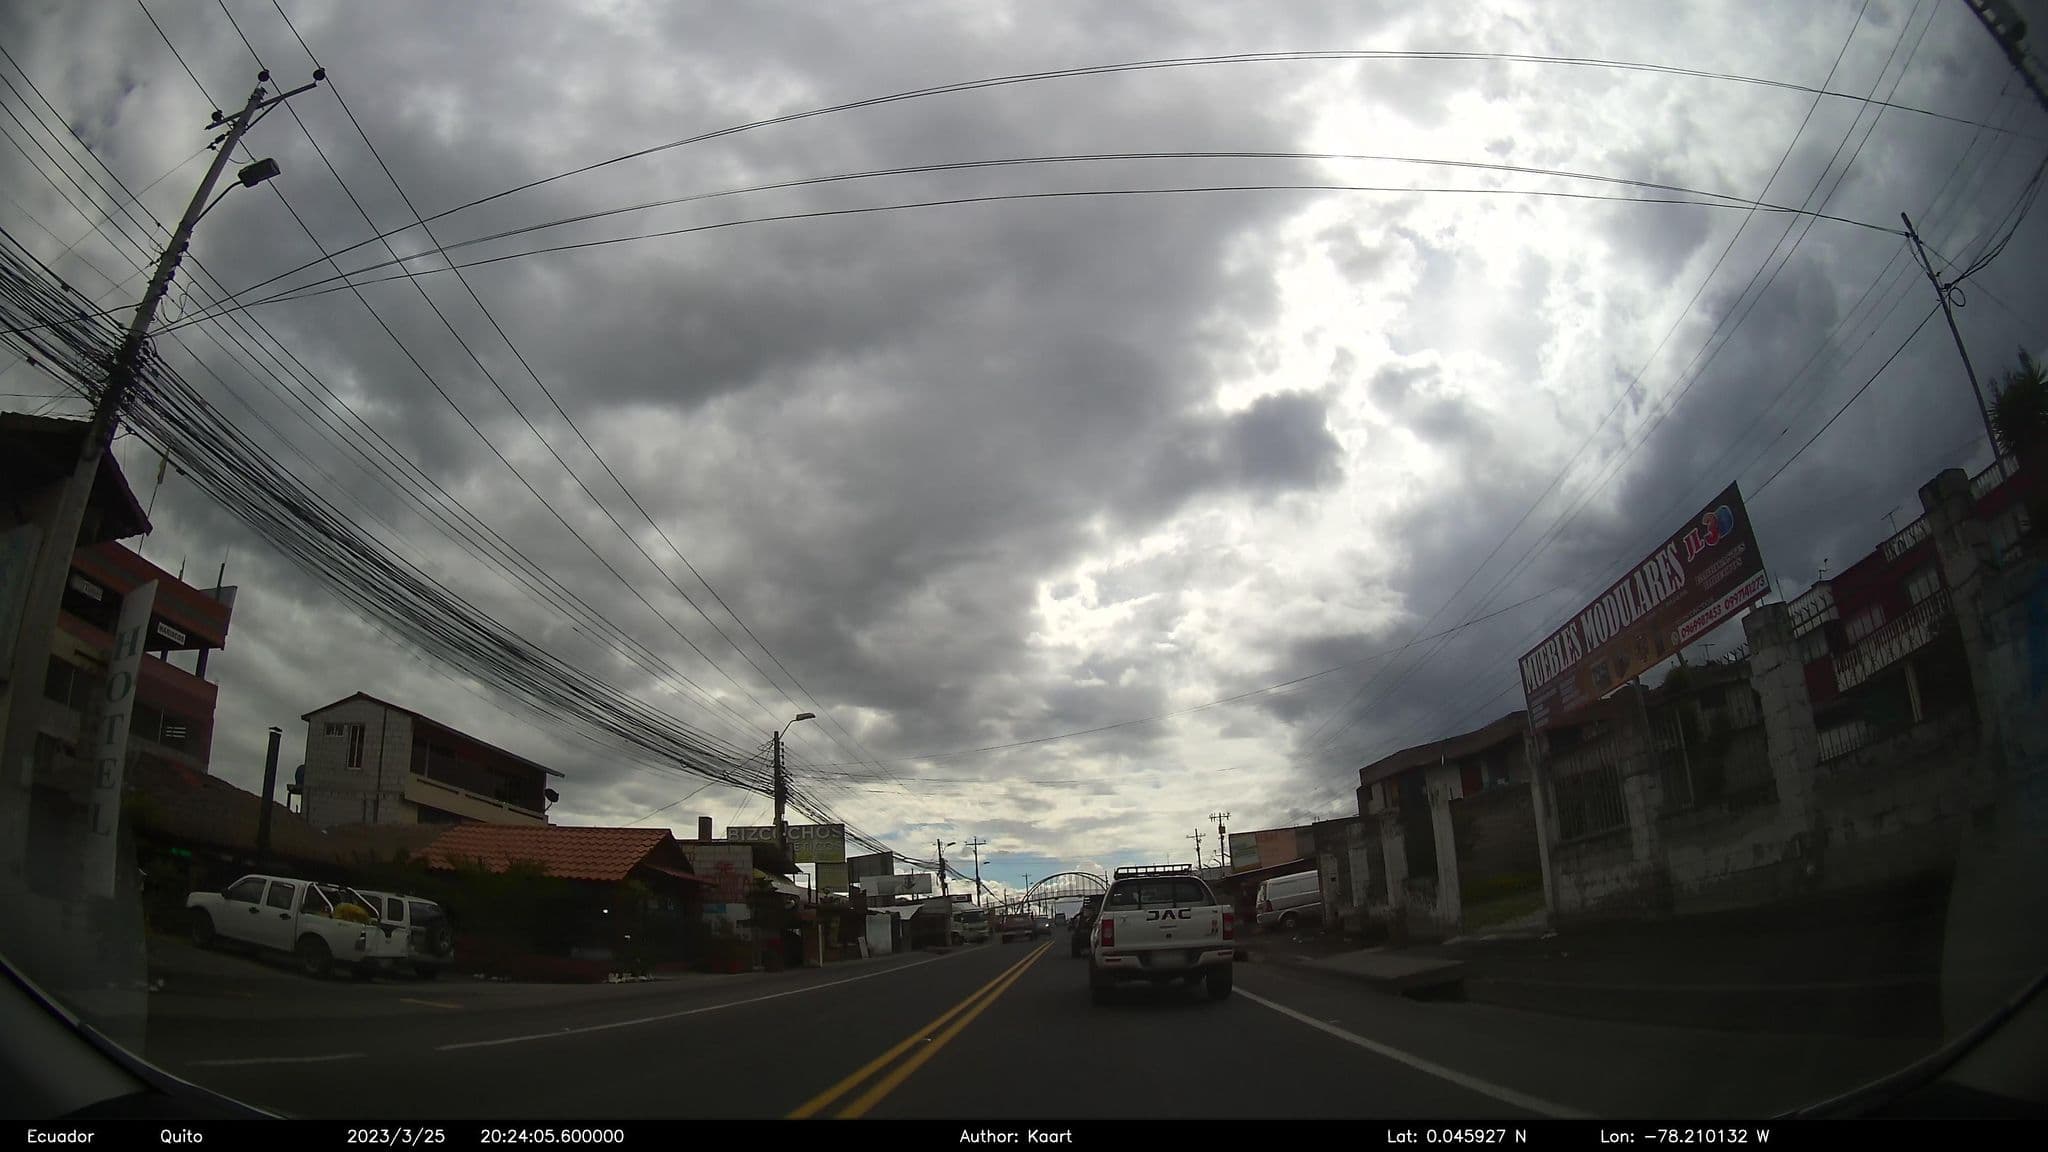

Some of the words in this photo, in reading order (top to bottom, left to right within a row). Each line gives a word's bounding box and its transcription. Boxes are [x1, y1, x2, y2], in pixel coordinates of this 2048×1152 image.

[1521, 621, 1584, 695] MUEBLES
[1580, 541, 1687, 653] MODULARES
[88, 626, 141, 836] HOTEL
